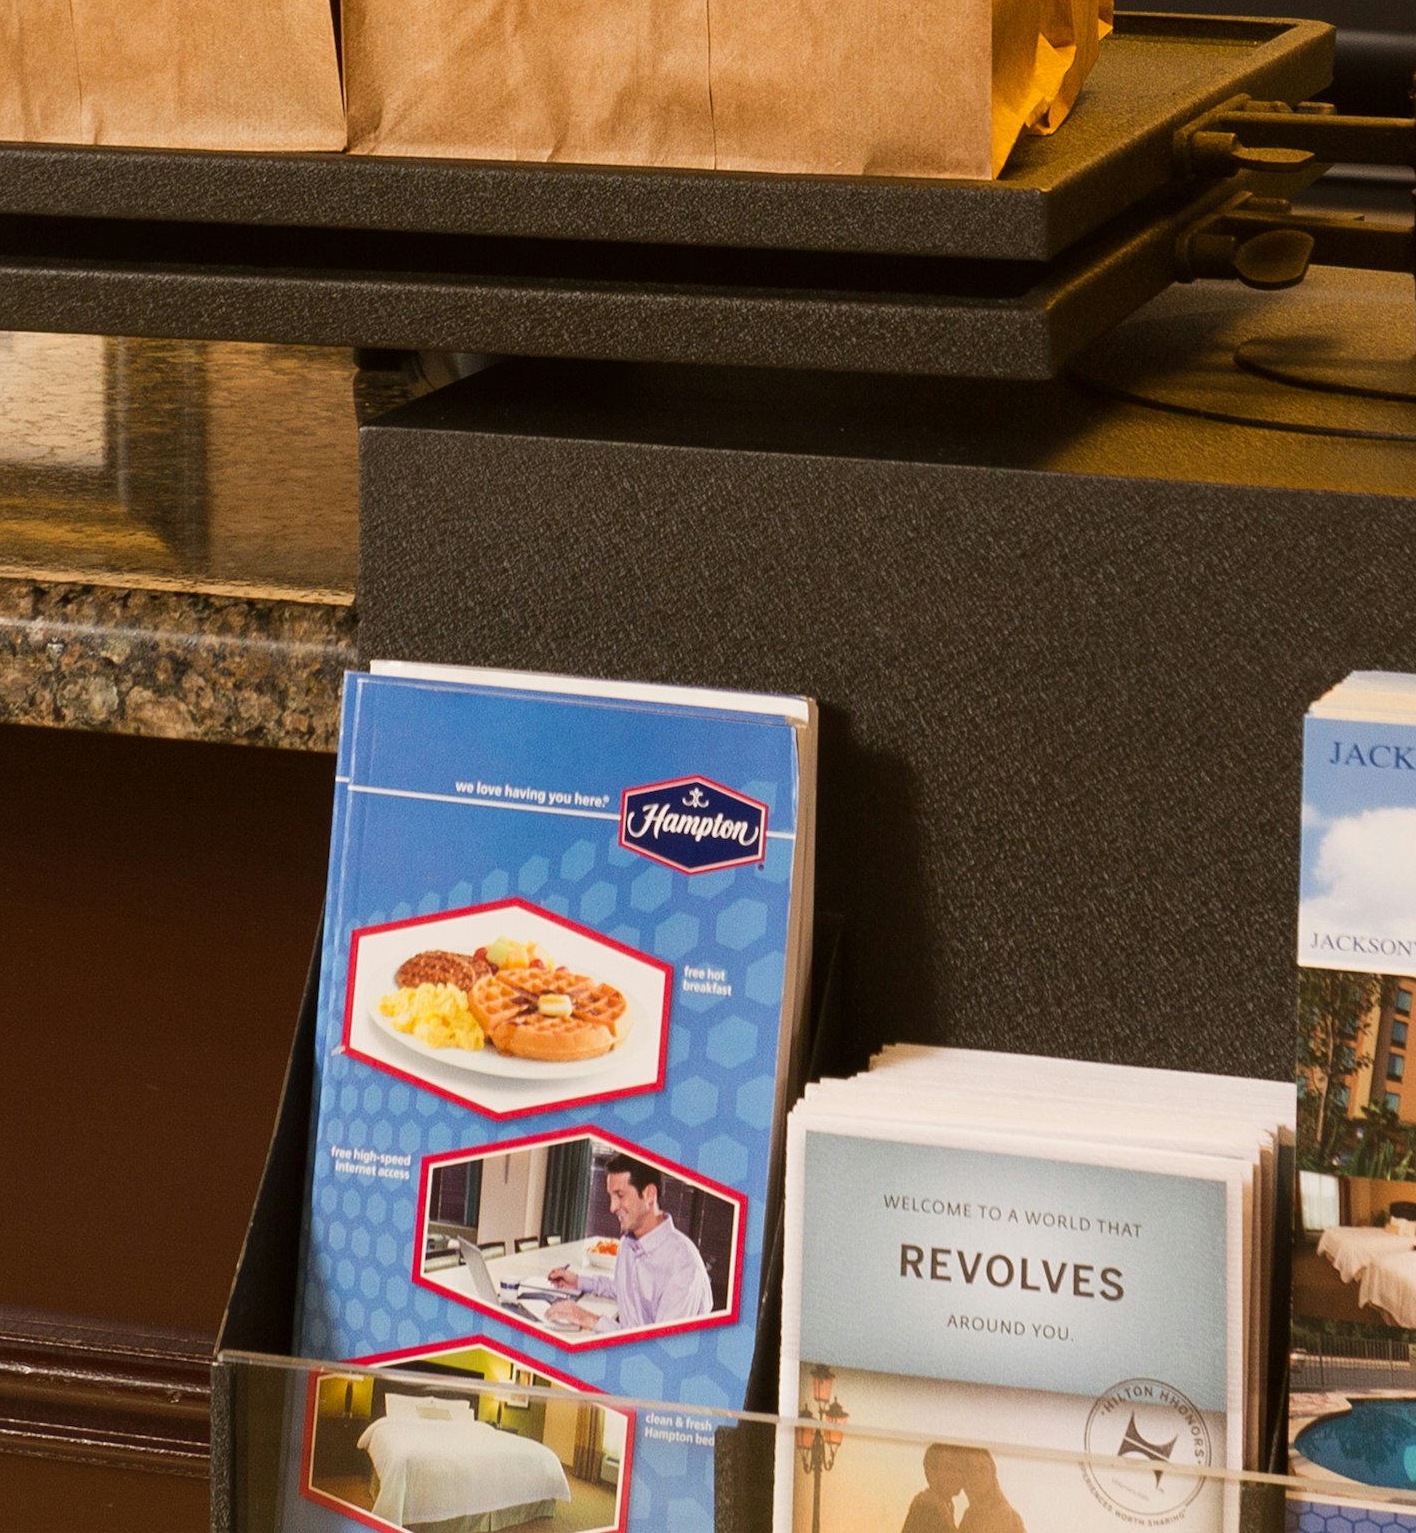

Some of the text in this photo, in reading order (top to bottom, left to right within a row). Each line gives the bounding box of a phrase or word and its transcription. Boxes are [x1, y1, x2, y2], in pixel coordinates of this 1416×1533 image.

[455, 781, 475, 794] we
[476, 781, 502, 798] love
[505, 787, 546, 805] having
[548, 792, 573, 806] you
[627, 804, 759, 846] Hampton
[684, 965, 725, 981] free hot
[683, 979, 732, 996] breakfast
[331, 1145, 411, 1166] free high-speed
[378, 1168, 410, 1180] access
[884, 1193, 1142, 1238] WELCOME TO A WORLD THAT
[900, 1243, 1126, 1302] REVOLVES
[947, 1314, 1075, 1342] AROUND YOU.
[645, 1412, 673, 1426] clean
[686, 1417, 712, 1431] fresh
[1103, 1386, 1205, 1458] HILTON HHONORS
[644, 1427, 693, 1444] Hampton
